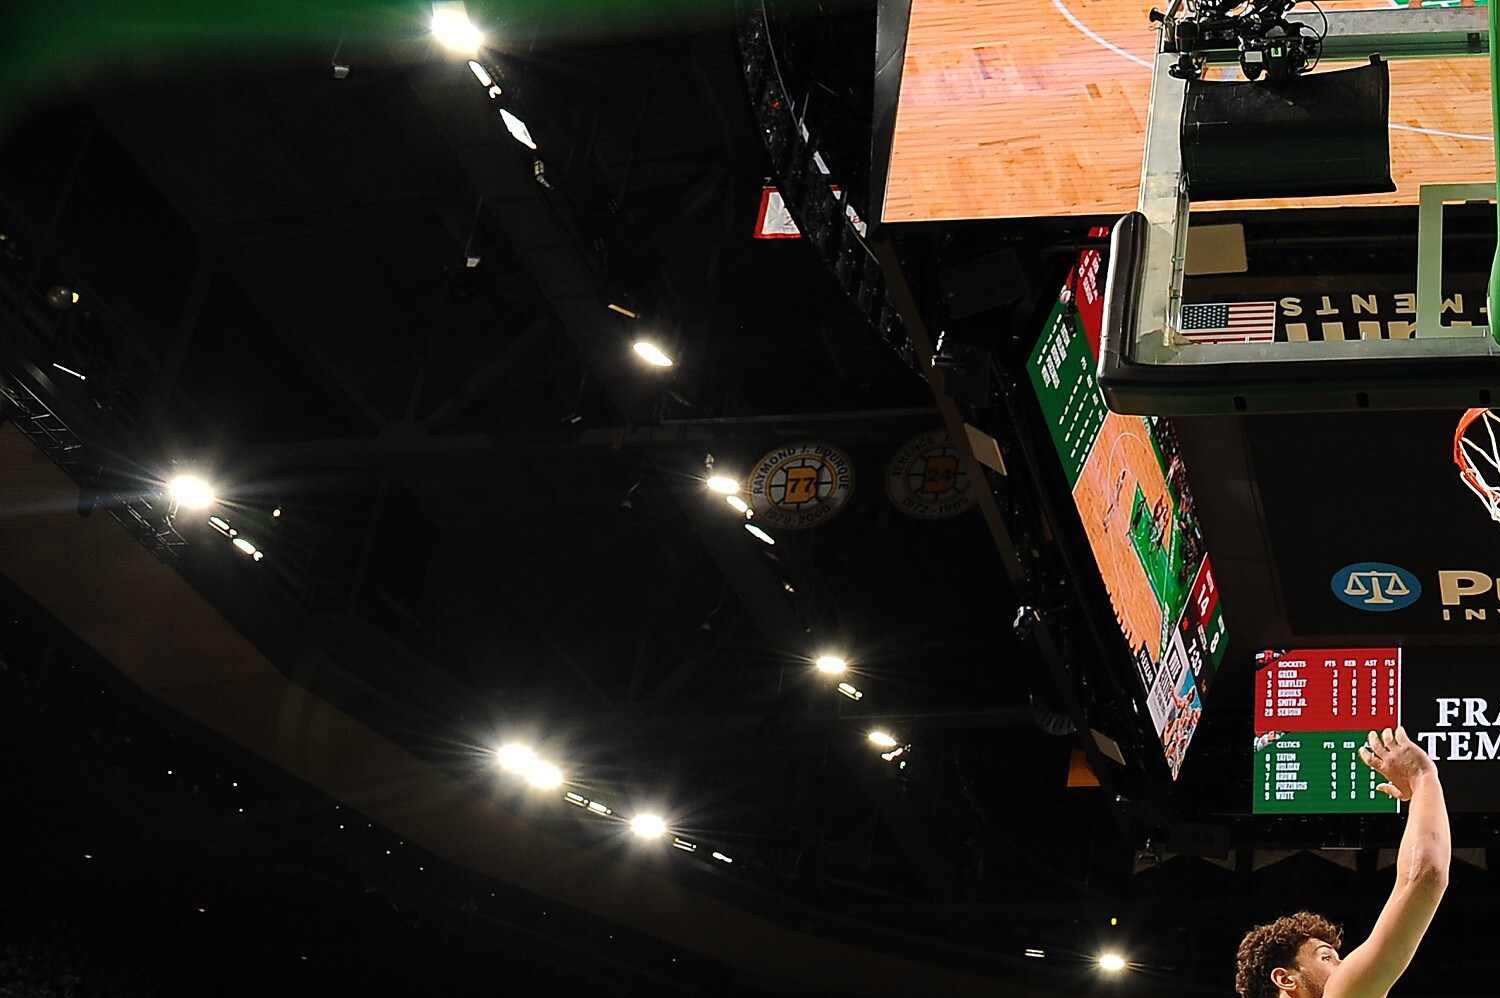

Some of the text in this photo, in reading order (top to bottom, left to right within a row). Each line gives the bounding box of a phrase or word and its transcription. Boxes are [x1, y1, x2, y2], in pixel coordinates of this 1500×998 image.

[752, 447, 796, 495] RAYMOND
[815, 445, 850, 491] BOURQUE
[789, 477, 815, 495] 77
